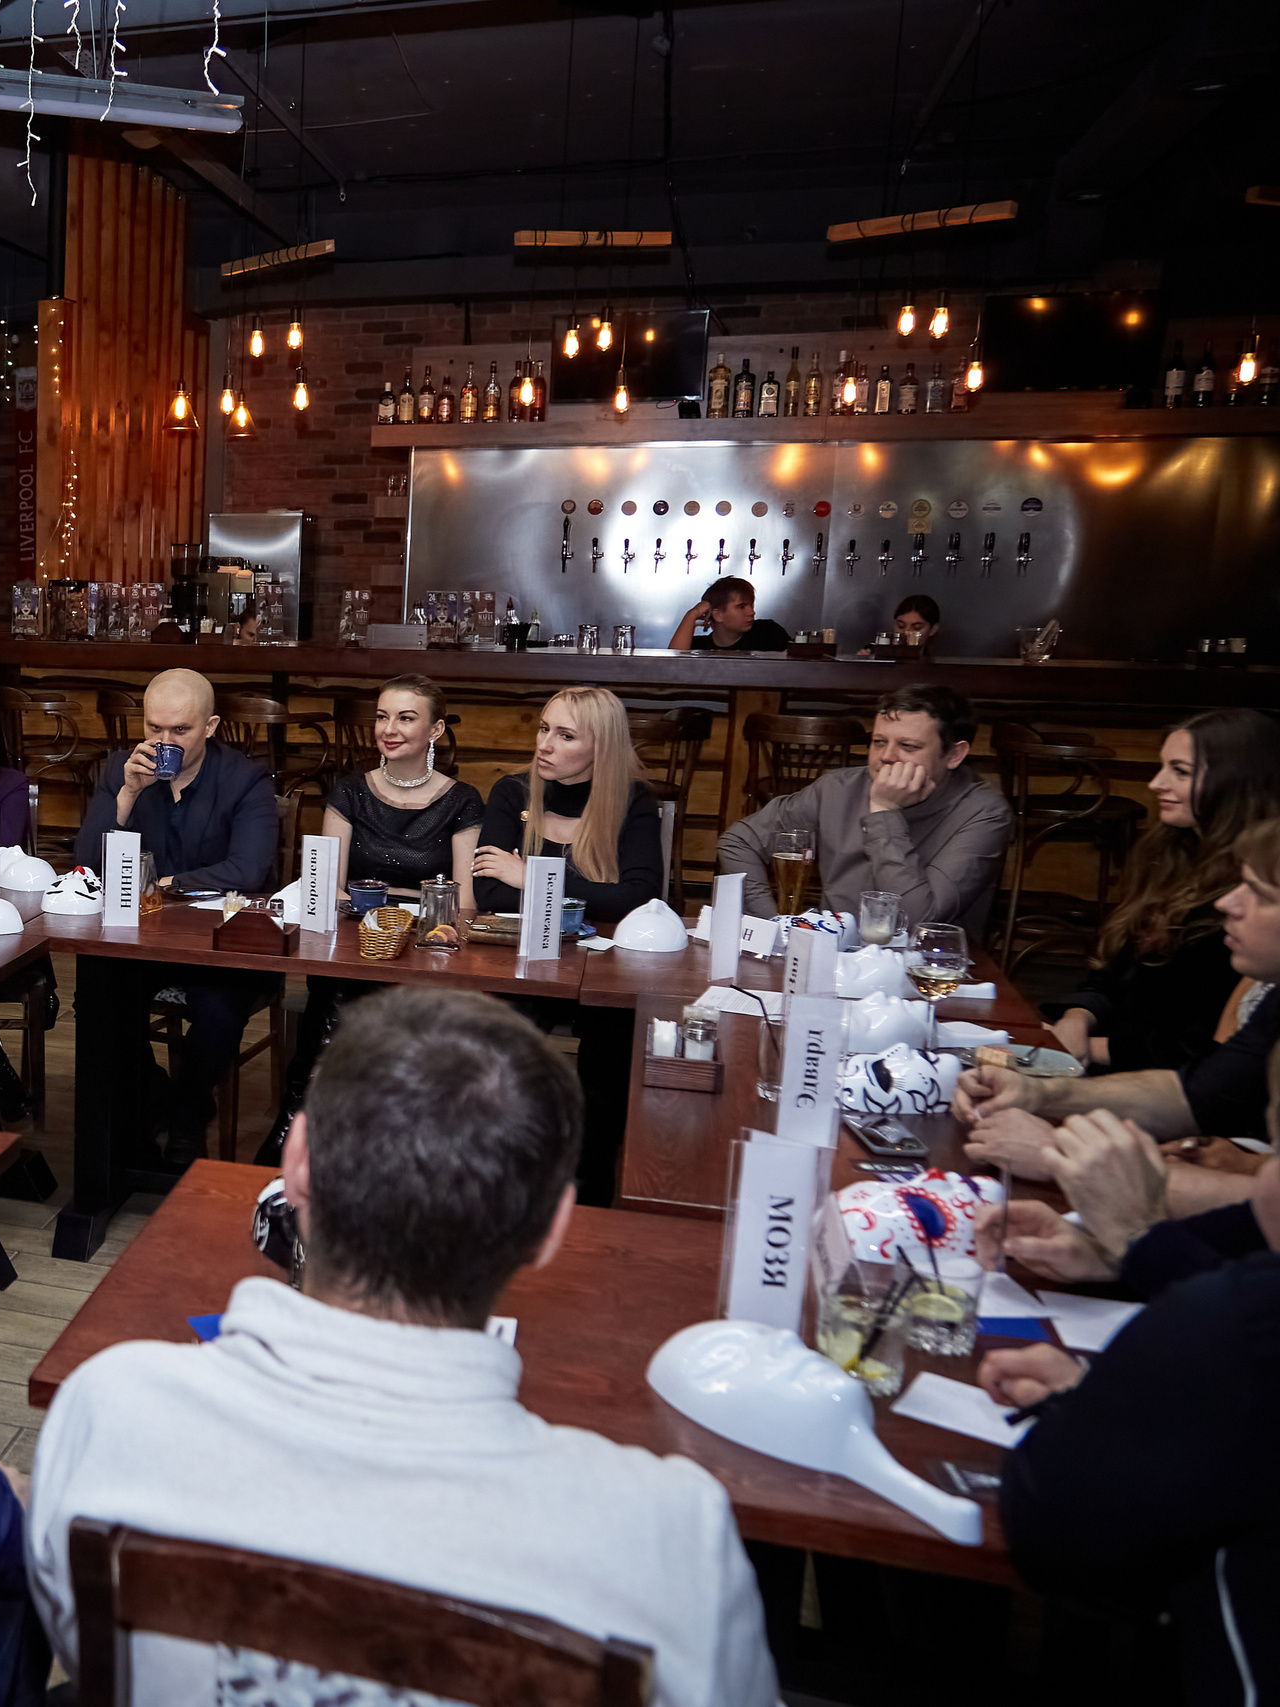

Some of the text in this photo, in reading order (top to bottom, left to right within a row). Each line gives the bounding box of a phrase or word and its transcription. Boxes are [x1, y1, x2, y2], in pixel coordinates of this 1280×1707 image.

[18, 429, 35, 562] LIVERPOOL FC
[120, 852, 133, 909] ЛЕНИН
[306, 848, 319, 916] Королева
[541, 871, 558, 950] Белоснежка
[795, 1029, 826, 1108] Эдвард
[761, 1195, 795, 1291] МОЗЯ
